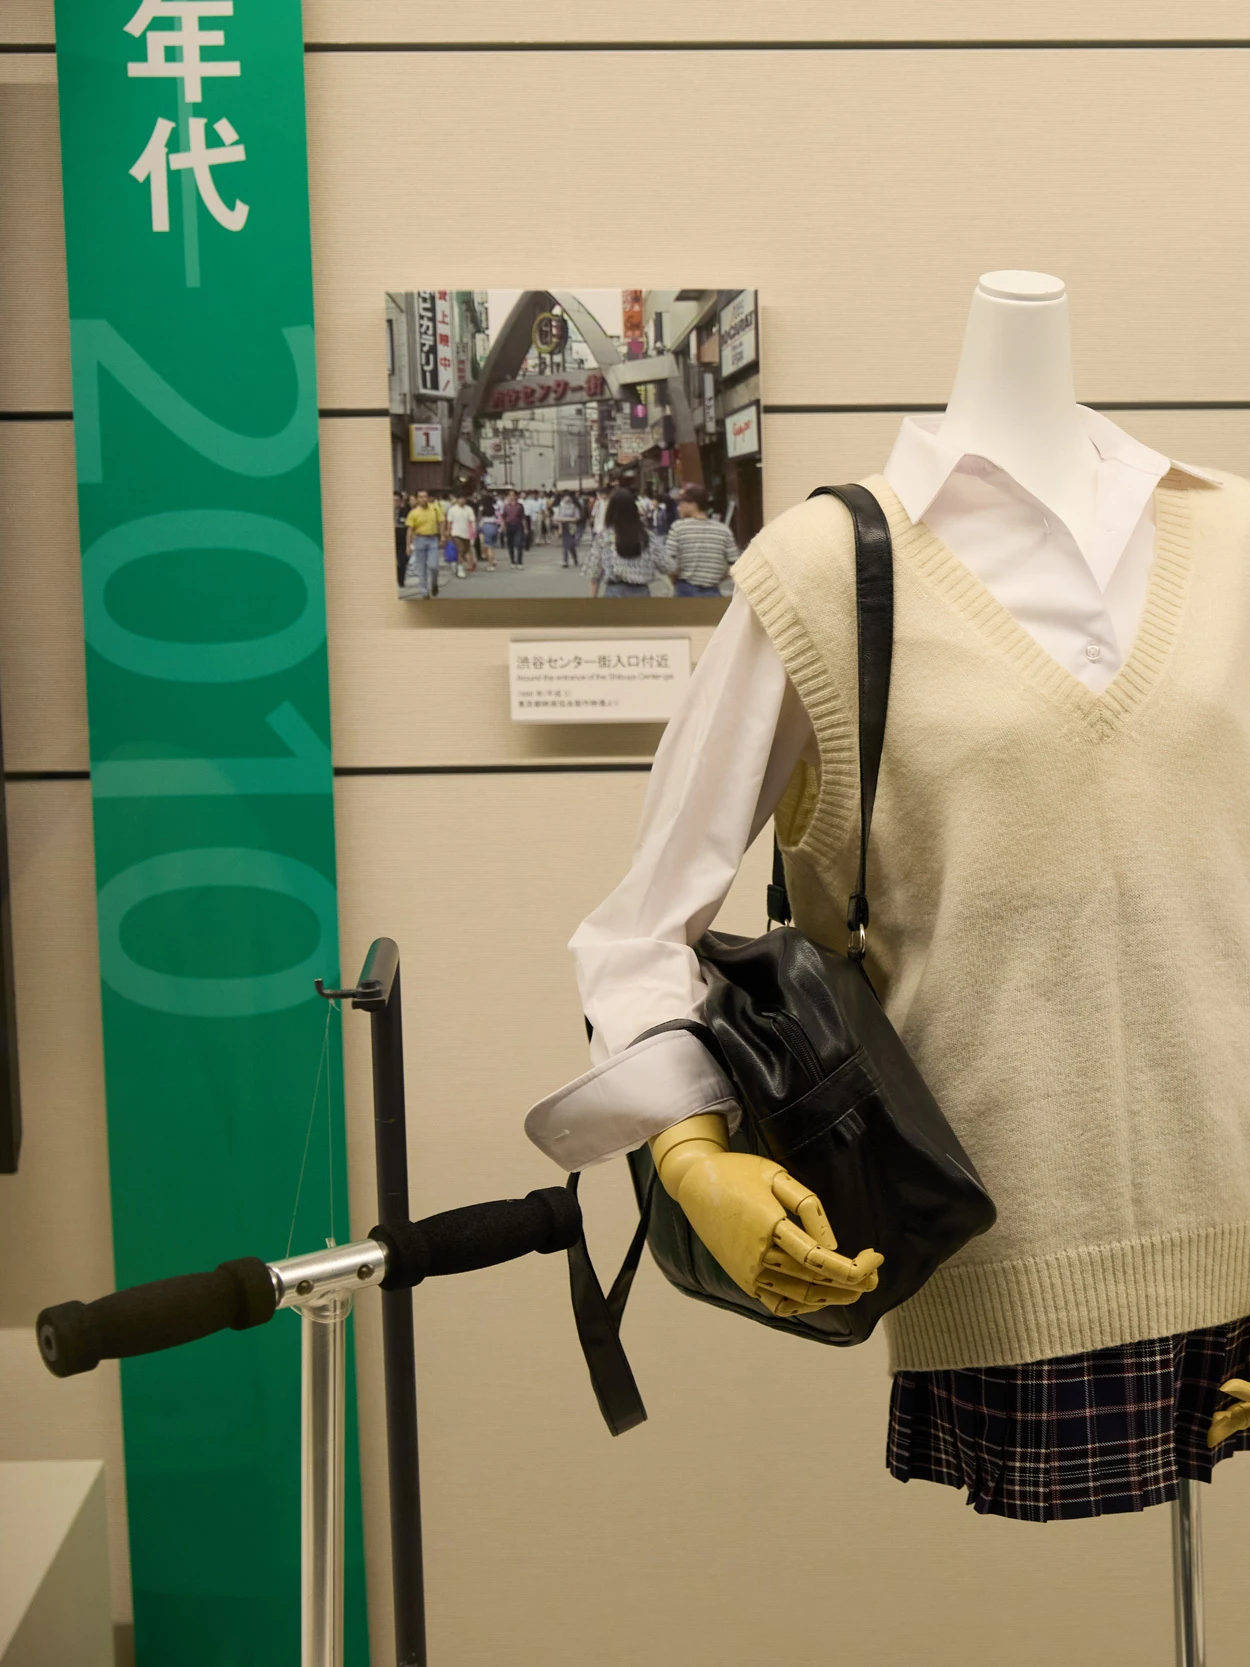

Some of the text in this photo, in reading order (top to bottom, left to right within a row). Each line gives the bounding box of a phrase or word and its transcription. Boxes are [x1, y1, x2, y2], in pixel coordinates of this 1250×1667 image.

[123, 0, 249, 232] 年代
[70, 319, 341, 1018] 2010
[516, 654, 670, 669] 渋谷センター街入口付近
